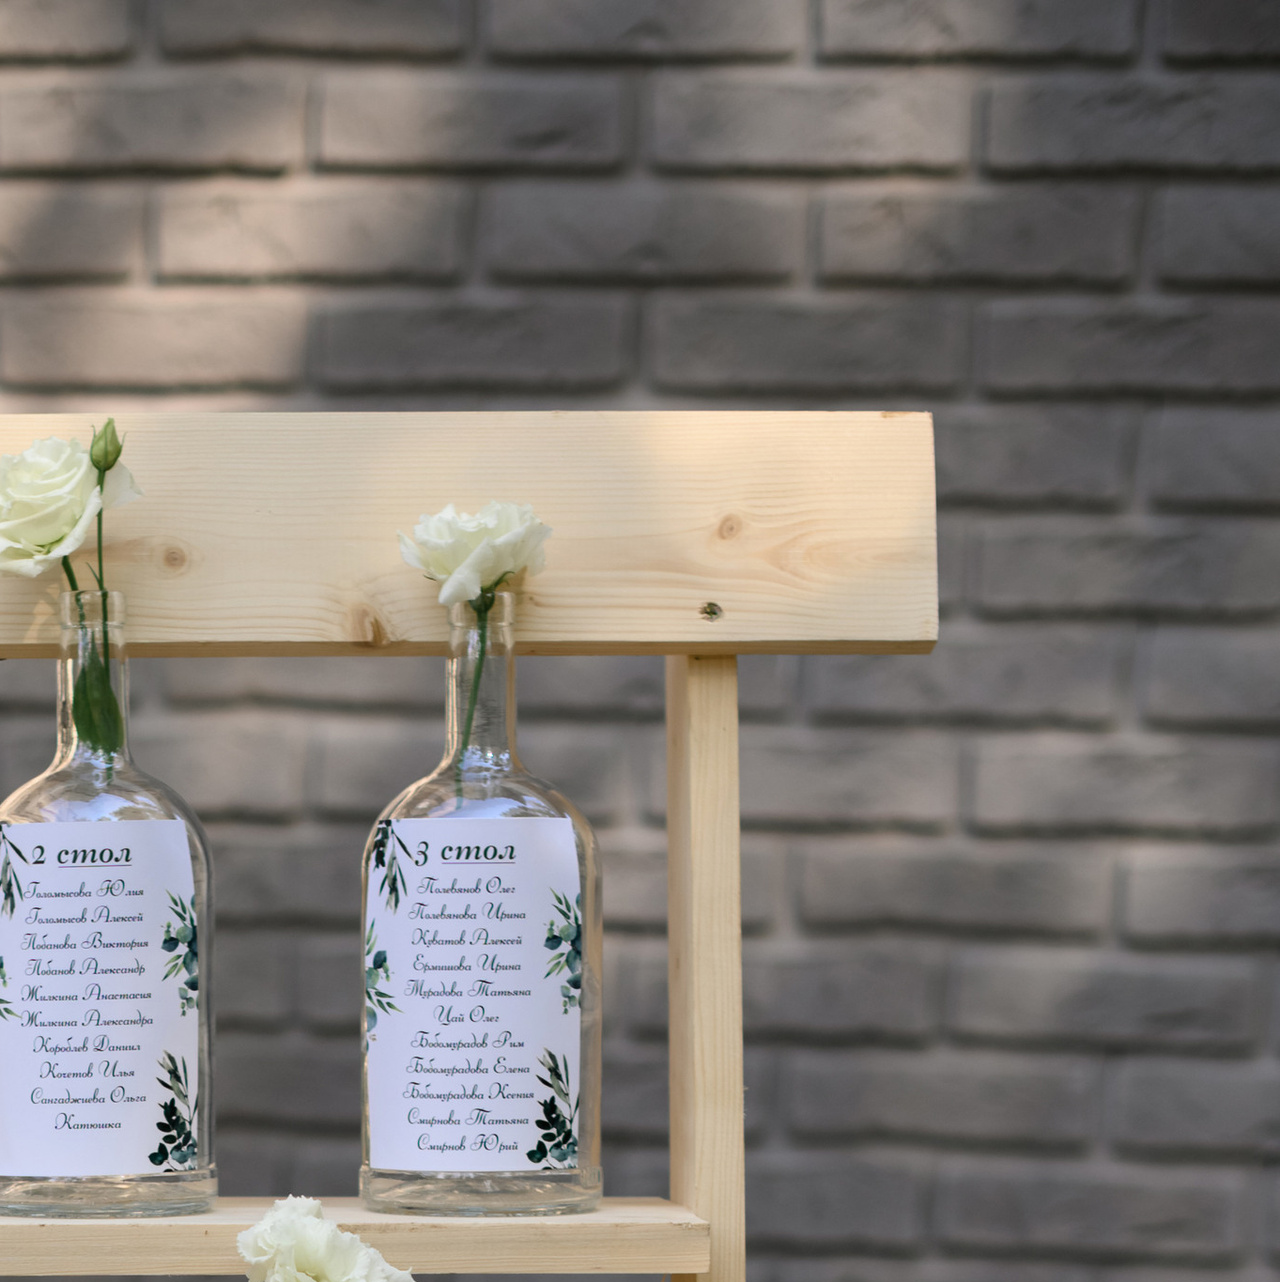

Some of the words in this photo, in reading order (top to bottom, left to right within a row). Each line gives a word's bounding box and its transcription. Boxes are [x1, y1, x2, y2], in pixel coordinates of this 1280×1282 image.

[32, 845, 45, 865] 2
[57, 847, 132, 864] стол
[414, 841, 429, 866] 3
[441, 844, 516, 860] стол
[23, 881, 92, 898] Голомысова
[96, 879, 144, 896] Юлия
[417, 877, 481, 894] Полевянов
[486, 876, 515, 894] Олег
[25, 907, 87, 924] Голомысов
[91, 905, 143, 923] Алексей
[408, 902, 477, 920] Полевянова
[482, 902, 526, 920] Ирина
[21, 933, 77, 950] Лобанова
[81, 931, 148, 950] Виктория
[470, 928, 522, 945] Алексей
[25, 959, 75, 976] Лобанов
[79, 957, 145, 976] Александр
[413, 954, 471, 972] Ермишова
[477, 954, 521, 972] Ирина
[21, 984, 78, 1002] Жилкина
[82, 983, 151, 1000] Анастасия
[404, 979, 463, 999] Мурадова
[467, 979, 531, 997] Татьяна
[21, 1010, 77, 1027] Жилкина
[82, 1009, 153, 1027] Александра
[433, 1005, 464, 1025] Цай
[469, 1005, 499, 1023] Олег
[93, 1035, 140, 1052] Даниил
[410, 1030, 488, 1050] Бобомурадов
[492, 1030, 525, 1048] Рим
[40, 1061, 93, 1079] Кочетов
[98, 1060, 135, 1077] Илья
[406, 1056, 489, 1076] Бобомурадова
[493, 1056, 530, 1074] Елена
[31, 1087, 105, 1104] Сангаджиева
[110, 1086, 146, 1103] Ольга
[403, 1082, 484, 1101] Бобомурадова
[488, 1082, 534, 1099] Ксения
[55, 1112, 121, 1130] Катюшка
[407, 1107, 460, 1126] Смирнова
[465, 1108, 529, 1125] Татьяна
[417, 1133, 466, 1153] Смирнов
[470, 1133, 518, 1153] Юрий
